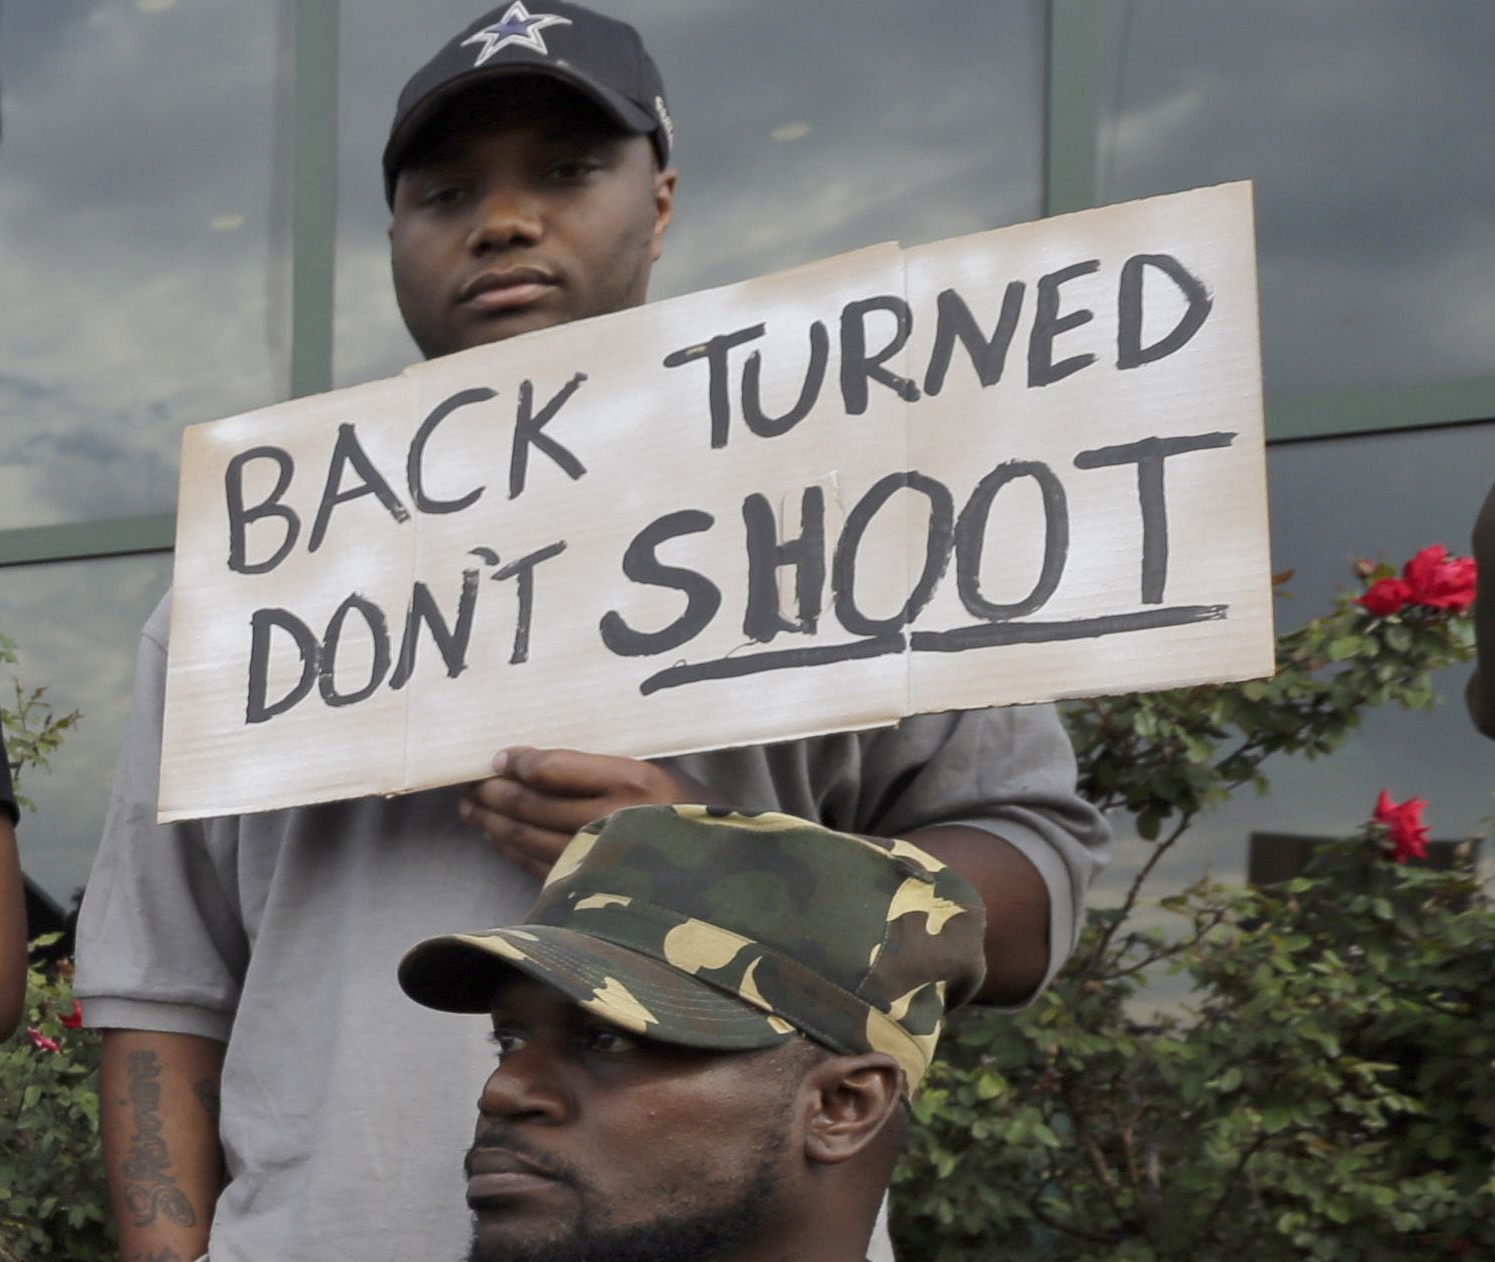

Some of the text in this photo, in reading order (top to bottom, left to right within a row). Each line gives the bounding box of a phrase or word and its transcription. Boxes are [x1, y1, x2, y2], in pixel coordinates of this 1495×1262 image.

[225, 253, 1212, 574] BACK TURNED
[246, 431, 1236, 723] DON'T SHOOT
